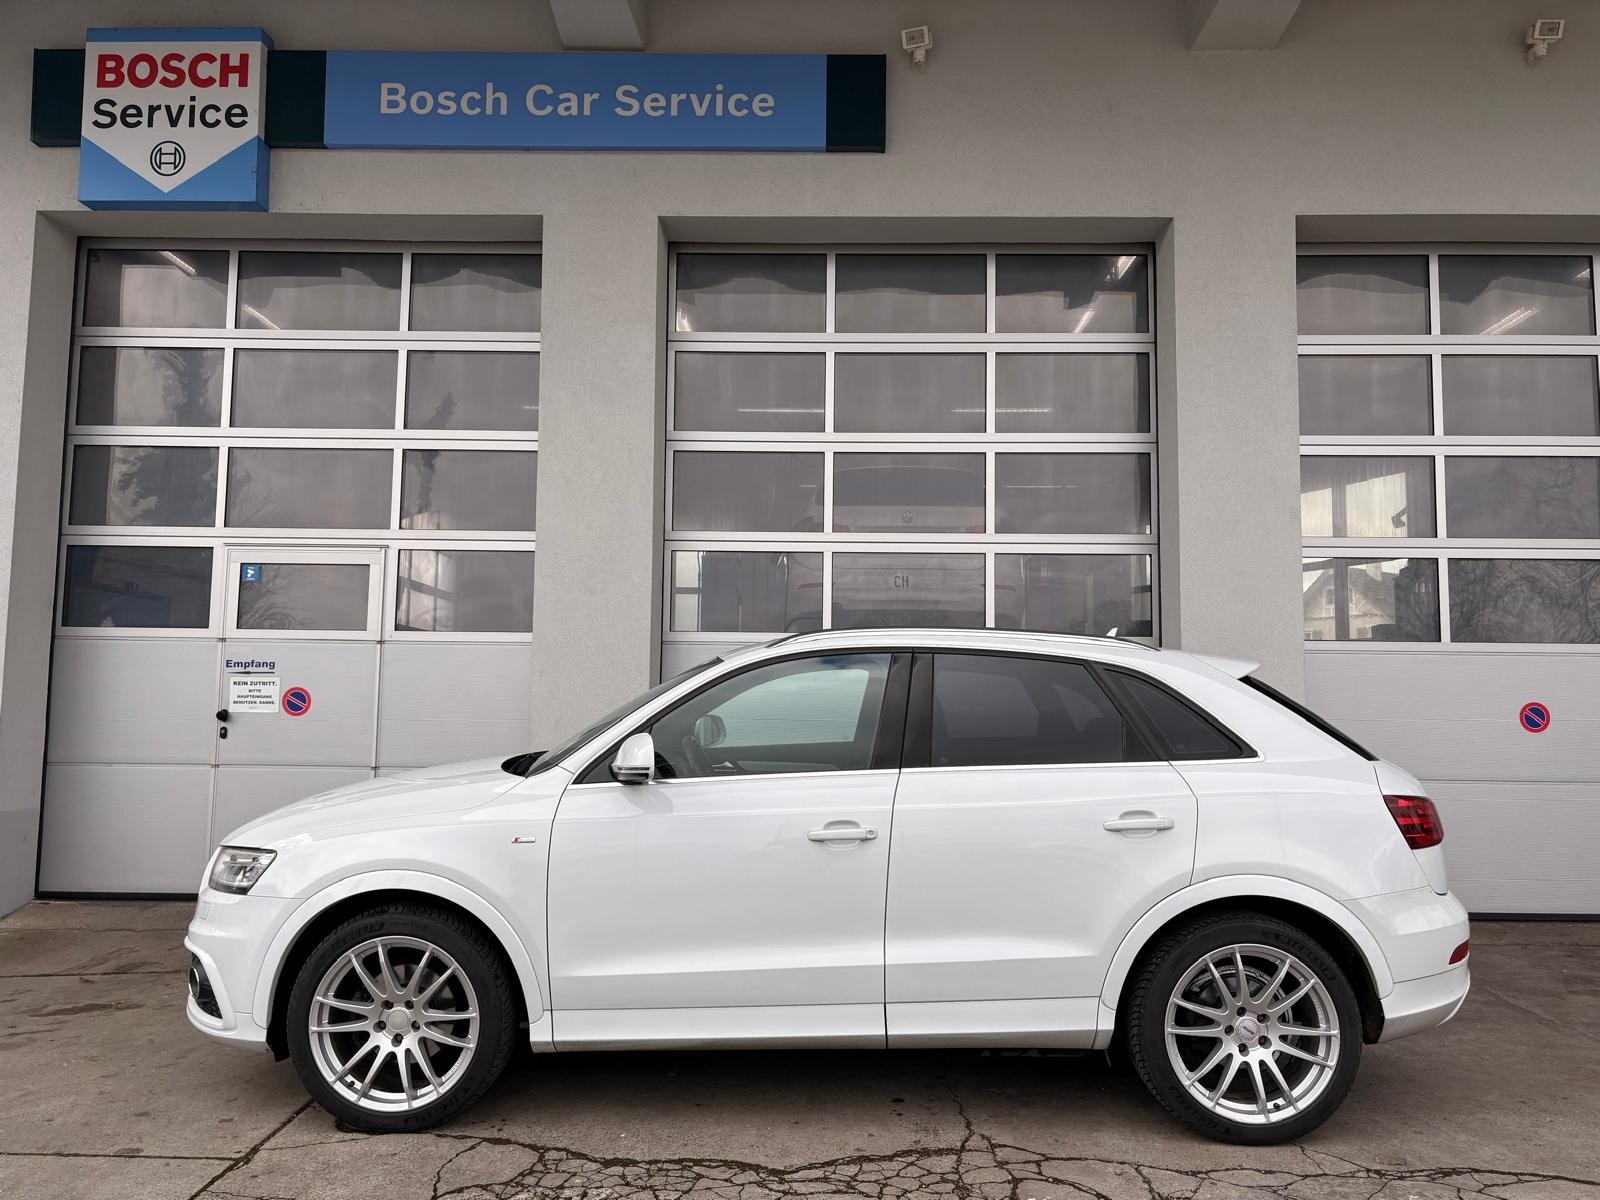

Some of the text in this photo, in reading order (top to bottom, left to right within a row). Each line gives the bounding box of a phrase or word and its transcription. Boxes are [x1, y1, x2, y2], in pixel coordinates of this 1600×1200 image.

[95, 53, 249, 89] BOSCH
[91, 95, 249, 129] Service
[379, 82, 776, 118] Bosch Car Service
[225, 659, 276, 670] Empfang
